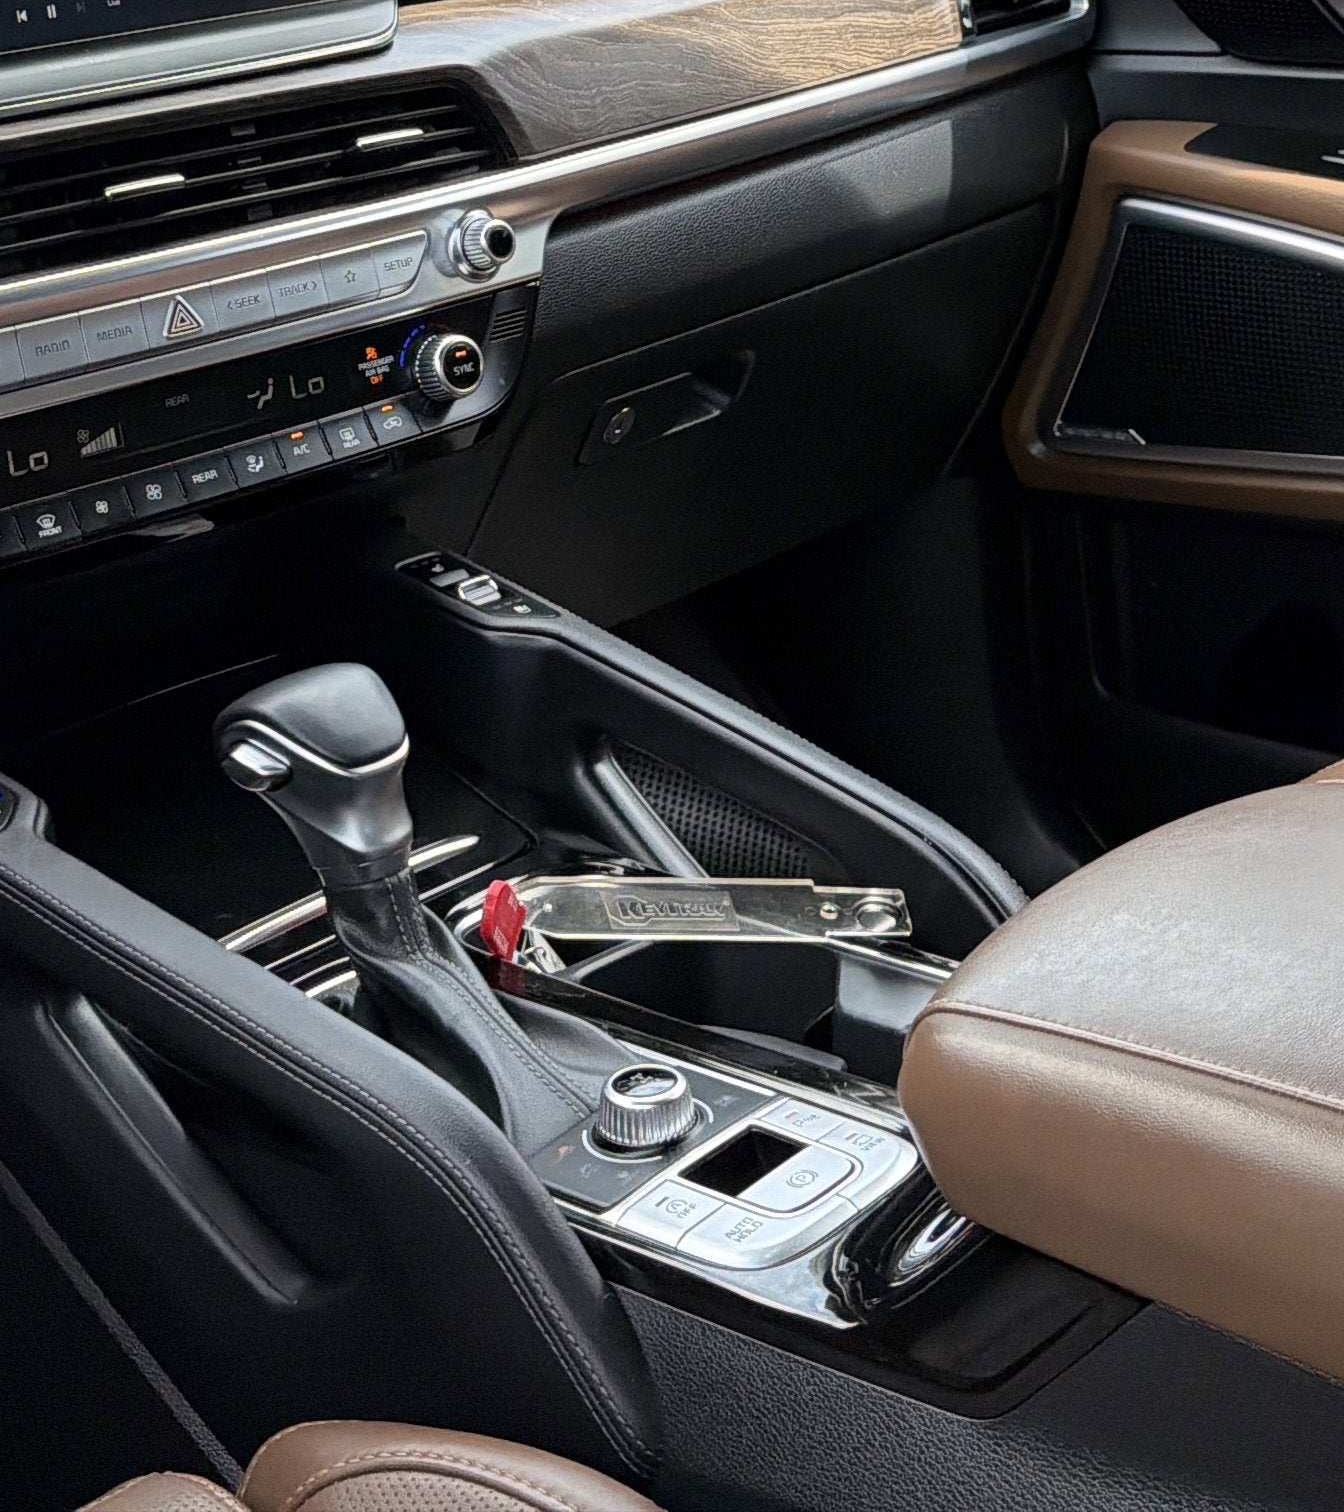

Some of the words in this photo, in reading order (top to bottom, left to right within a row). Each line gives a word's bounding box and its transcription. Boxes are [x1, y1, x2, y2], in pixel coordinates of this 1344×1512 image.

[383, 257, 414, 271] SETUP
[279, 283, 311, 297] TRACK
[234, 295, 261, 309] SEEK
[96, 325, 134, 342] MEDIA
[34, 340, 71, 357] RADIO
[453, 361, 475, 377] SYNC
[288, 374, 325, 400] Lo
[164, 393, 190, 408] REAR
[292, 444, 311, 457] A/C
[6, 450, 49, 477] Lo
[191, 469, 219, 484] REAR
[676, 1202, 697, 1219] OFF
[724, 1216, 754, 1239] AUTO
[733, 1220, 764, 1243] HOLD
